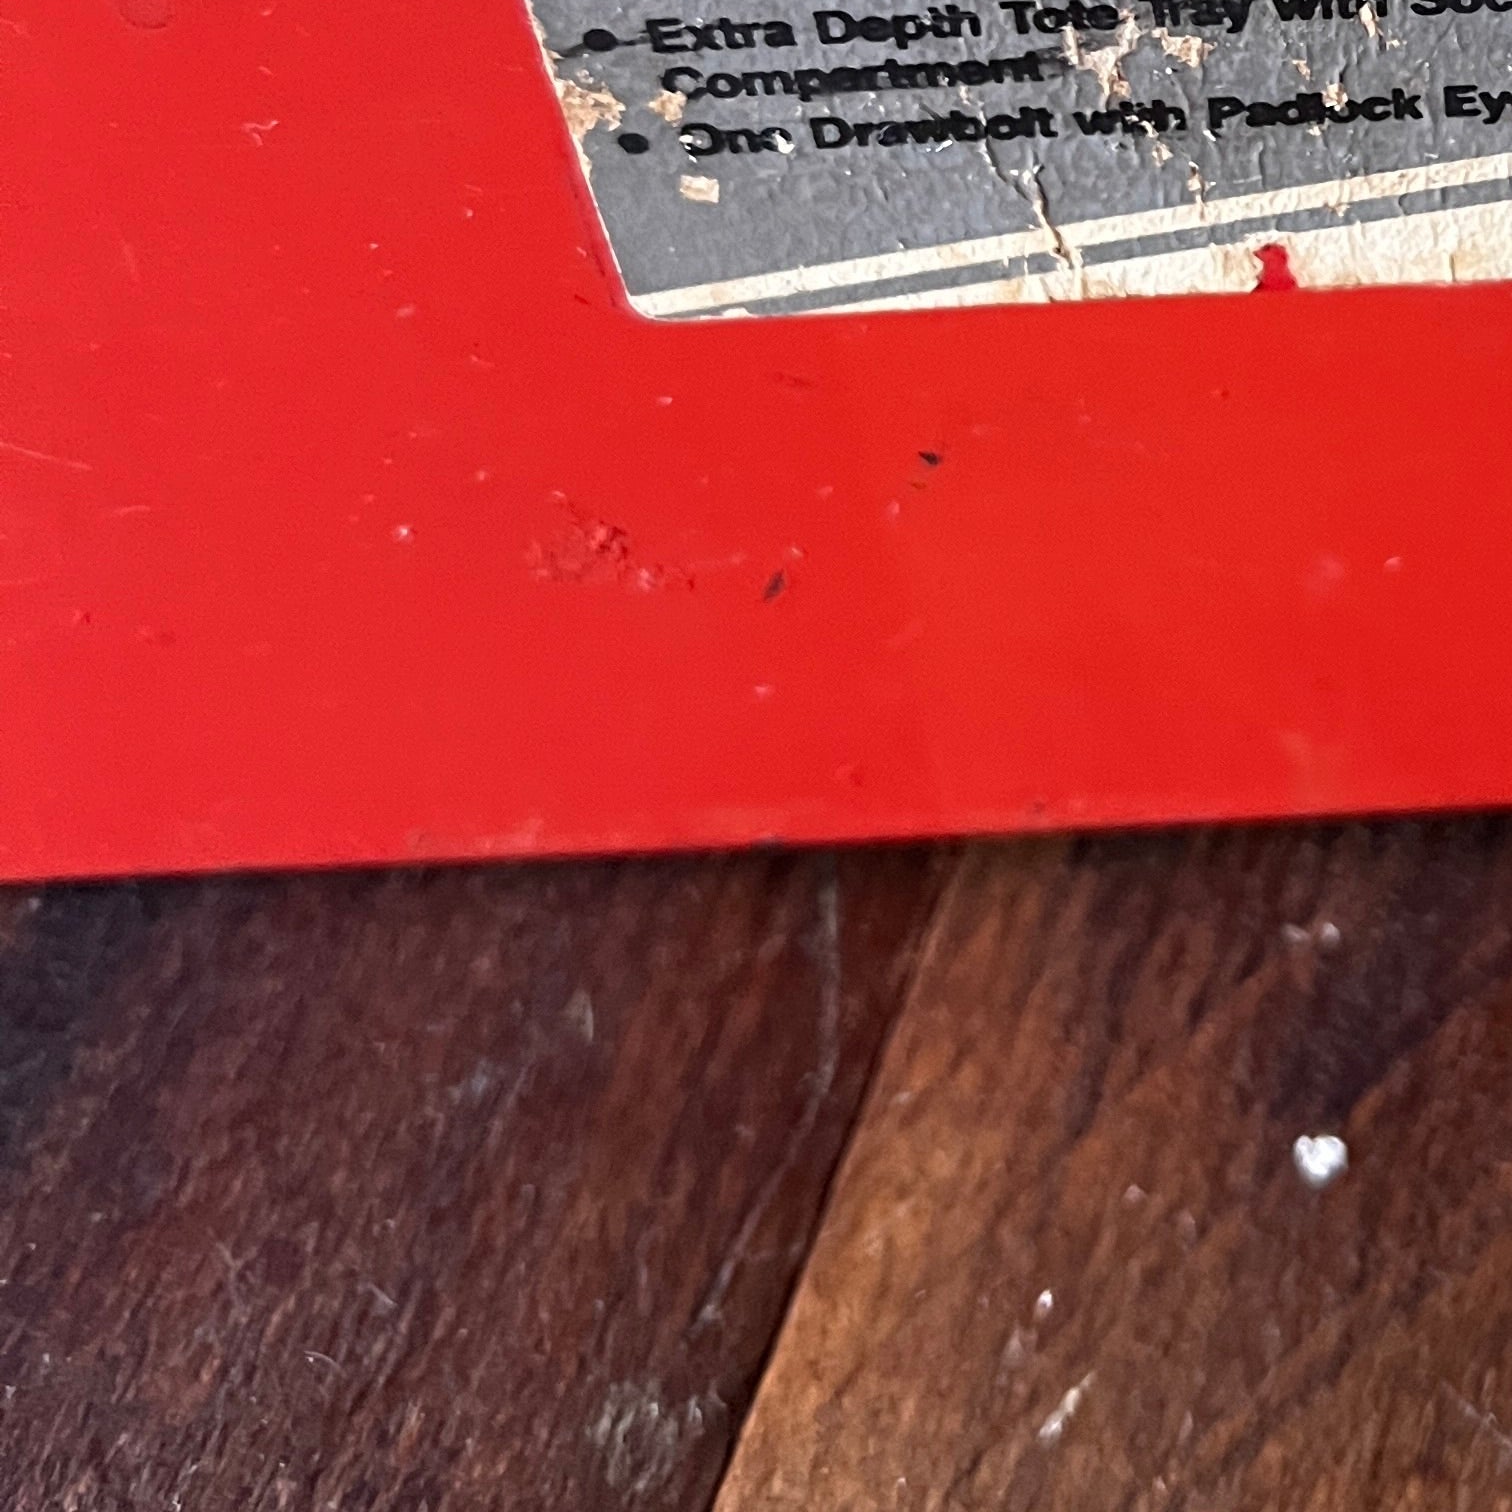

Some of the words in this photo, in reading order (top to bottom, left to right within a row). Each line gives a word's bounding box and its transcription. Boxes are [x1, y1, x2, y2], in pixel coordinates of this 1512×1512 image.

[645, 17, 796, 54] Extra
[813, 3, 982, 50] Depth
[999, 0, 1122, 34] Tote
[661, 52, 1045, 102] Compartment
[810, 105, 1058, 150] Drawbolt
[1072, 99, 1187, 137] with
[1207, 88, 1424, 131] Padlock
